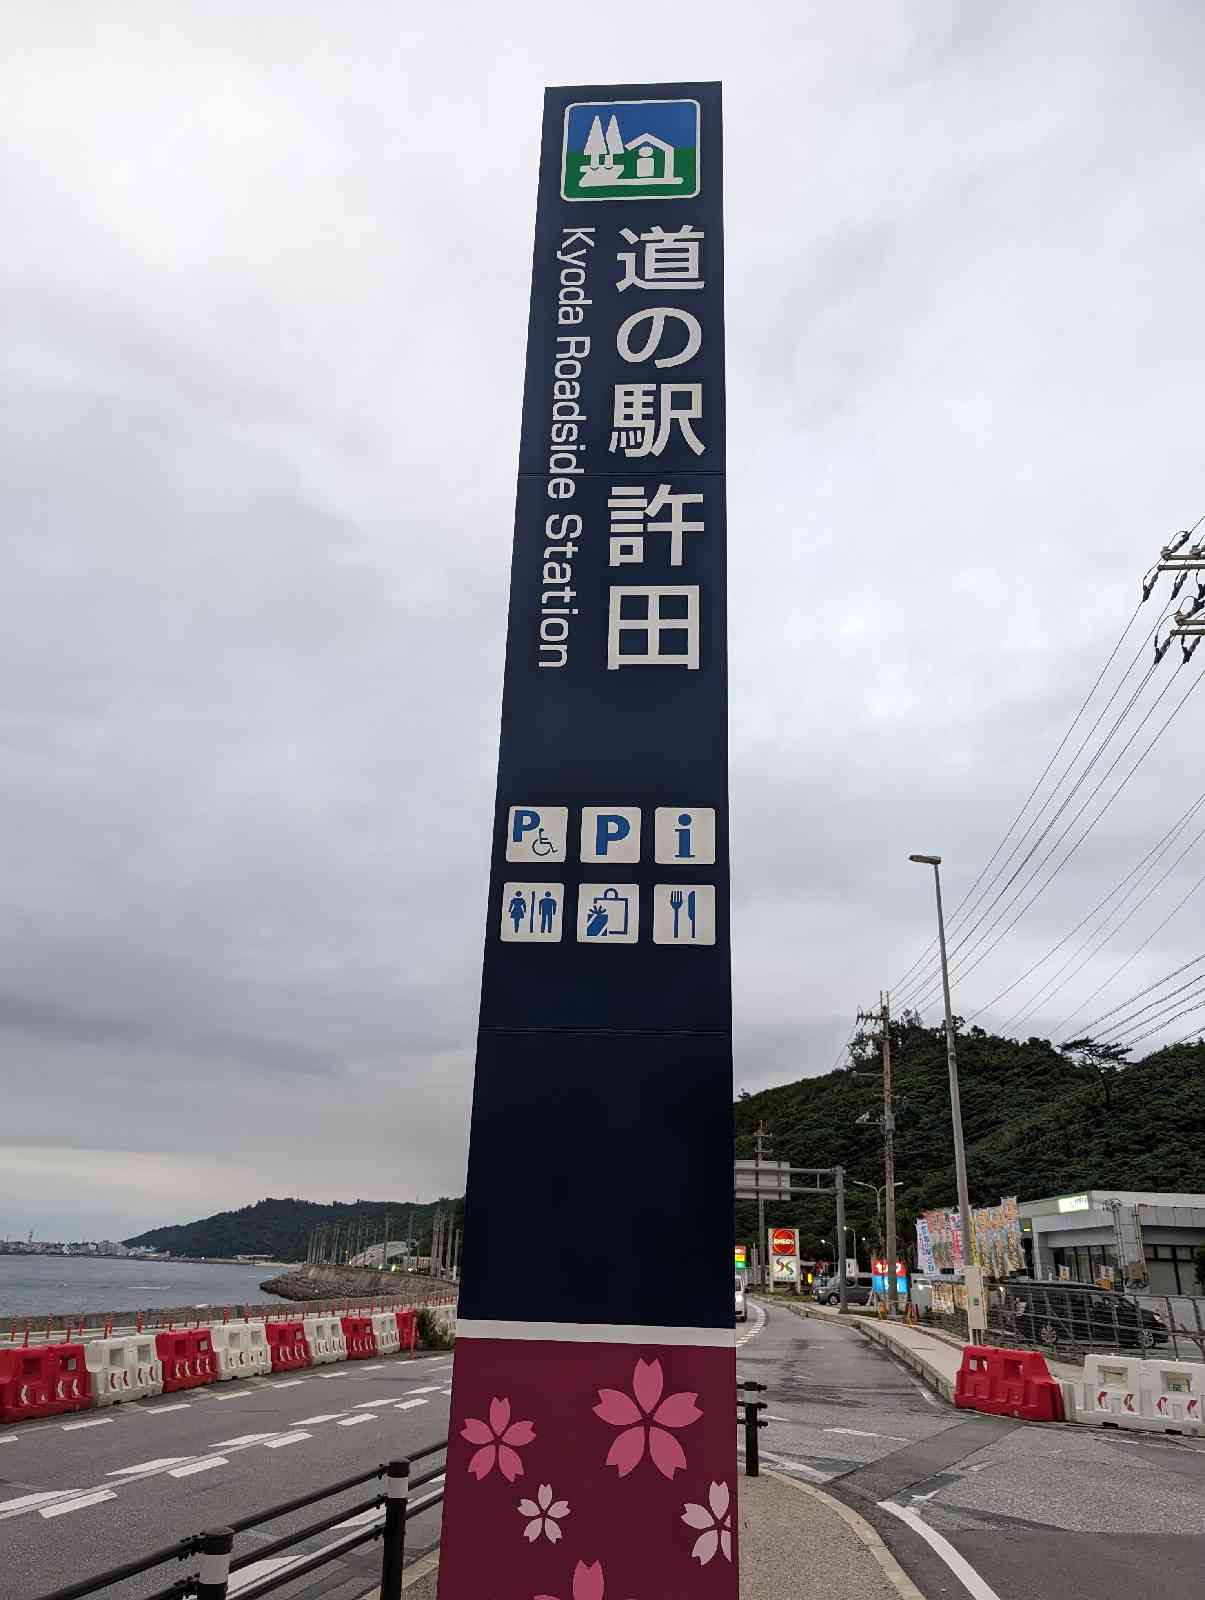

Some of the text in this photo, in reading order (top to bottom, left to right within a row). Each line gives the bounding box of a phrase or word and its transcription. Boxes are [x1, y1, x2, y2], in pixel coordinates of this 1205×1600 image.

[538, 227, 596, 668] Kyoda Roadside Station
[512, 809, 541, 842] P
[596, 814, 631, 856] P
